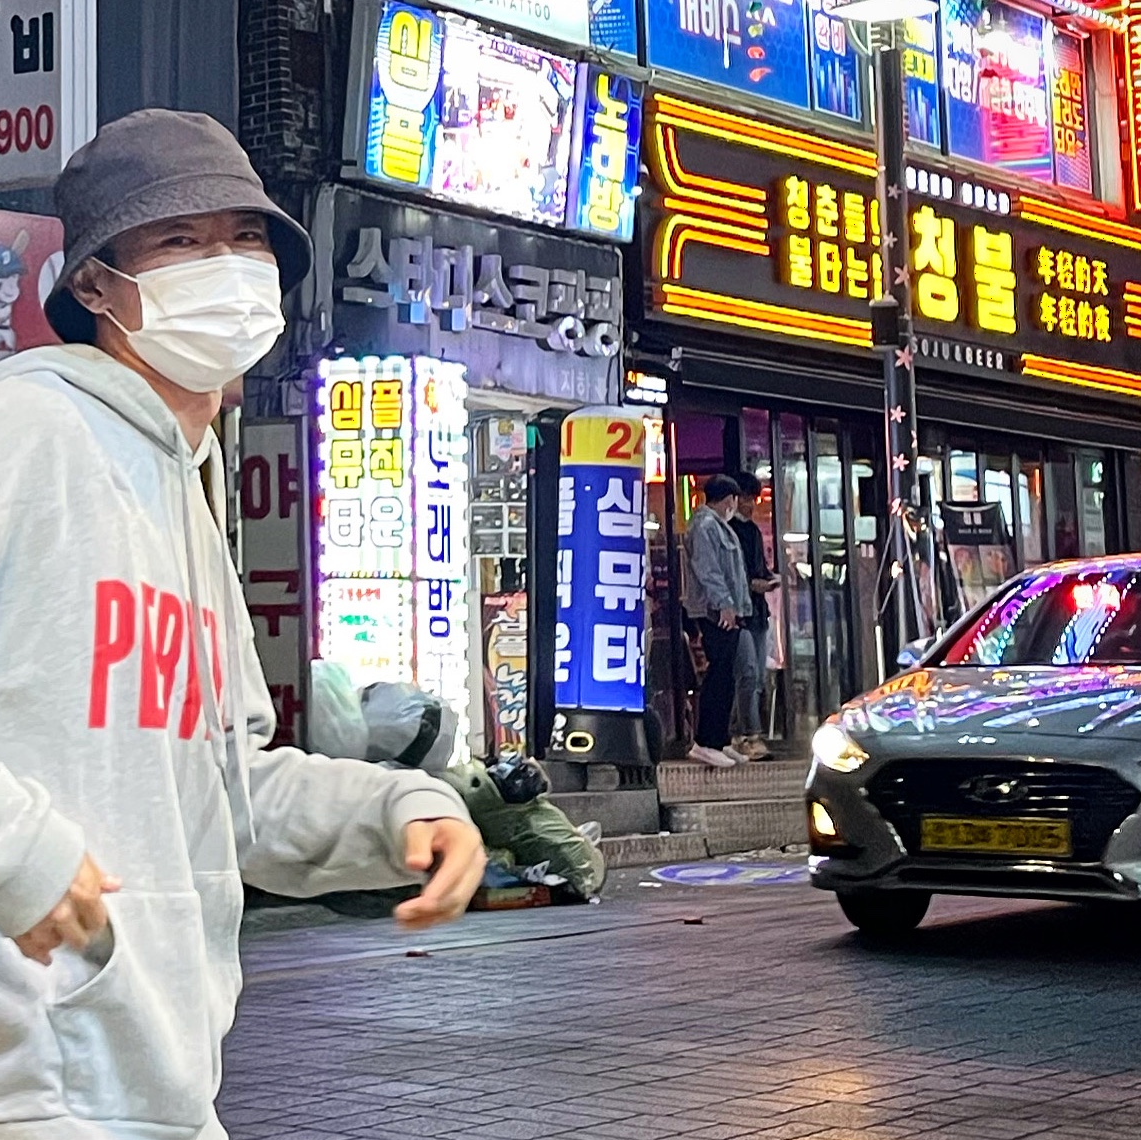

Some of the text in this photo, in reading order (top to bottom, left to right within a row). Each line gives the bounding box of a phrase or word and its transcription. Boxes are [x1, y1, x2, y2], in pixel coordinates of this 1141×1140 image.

[785, 175, 1017, 335] 청춘들 청불
[788, 234, 883, 299] 불타는
